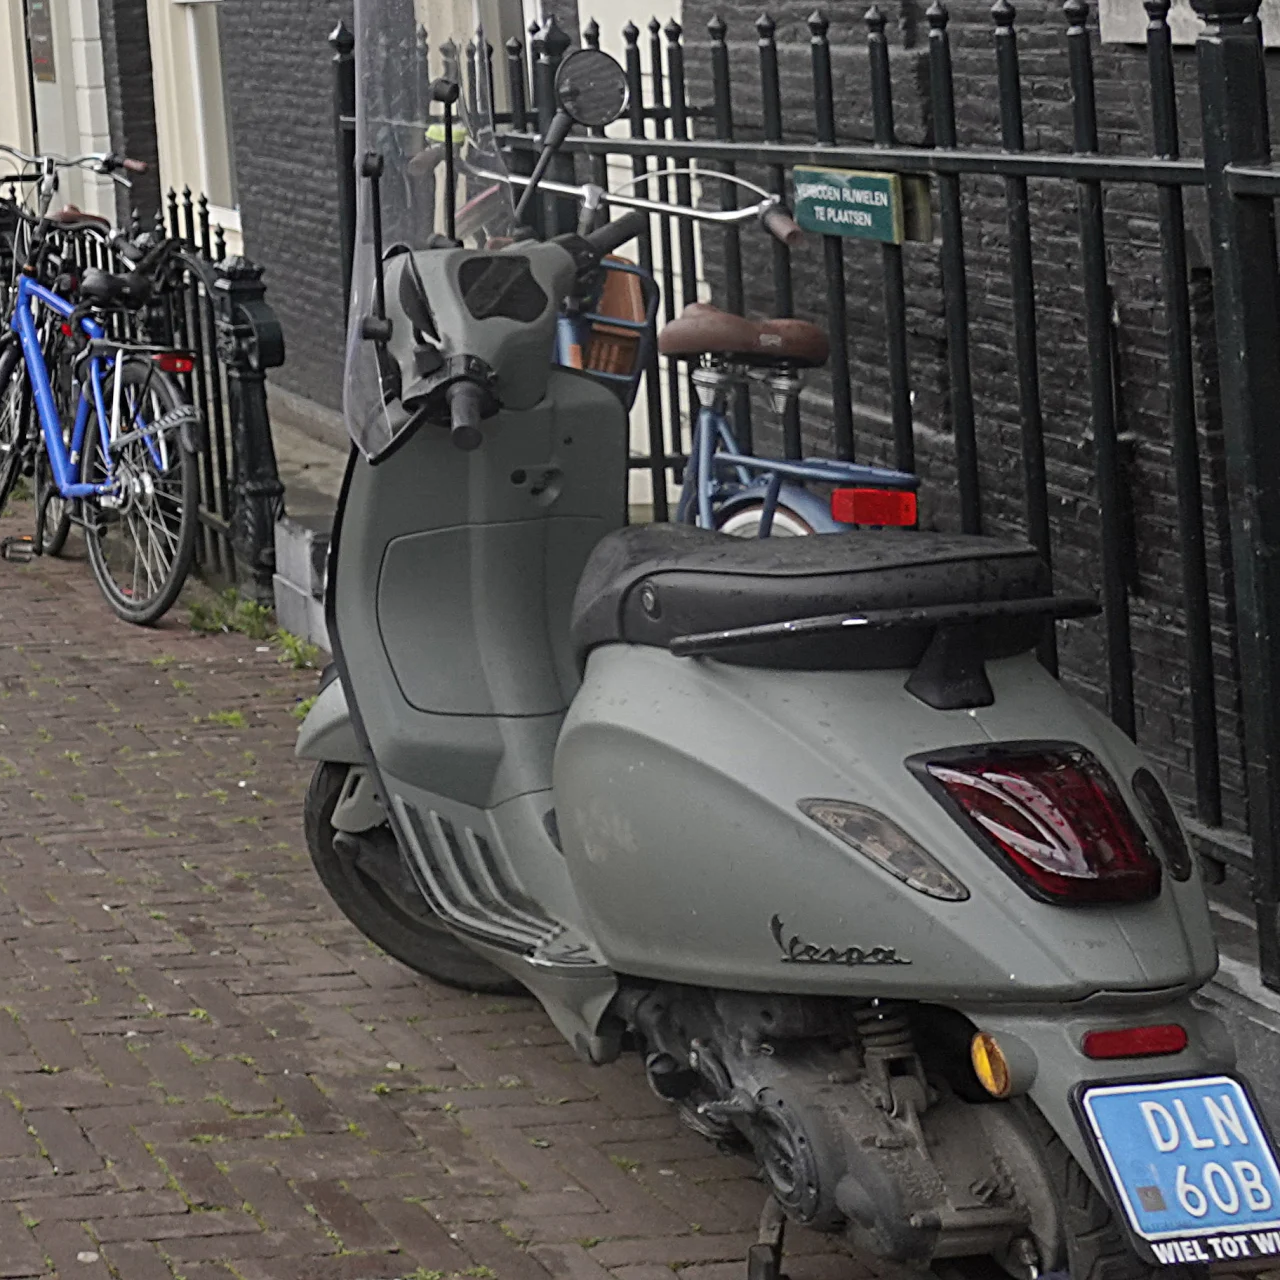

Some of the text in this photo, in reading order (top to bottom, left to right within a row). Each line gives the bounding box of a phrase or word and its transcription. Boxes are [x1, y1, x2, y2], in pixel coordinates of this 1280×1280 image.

[813, 205, 872, 226] TE PLAATSEN
[771, 914, 913, 966] Vespa
[1139, 1094, 1249, 1153] DLN
[1176, 1160, 1273, 1217] 60B
[1151, 1240, 1209, 1264] WIEL
[1208, 1234, 1251, 1259] TOT
